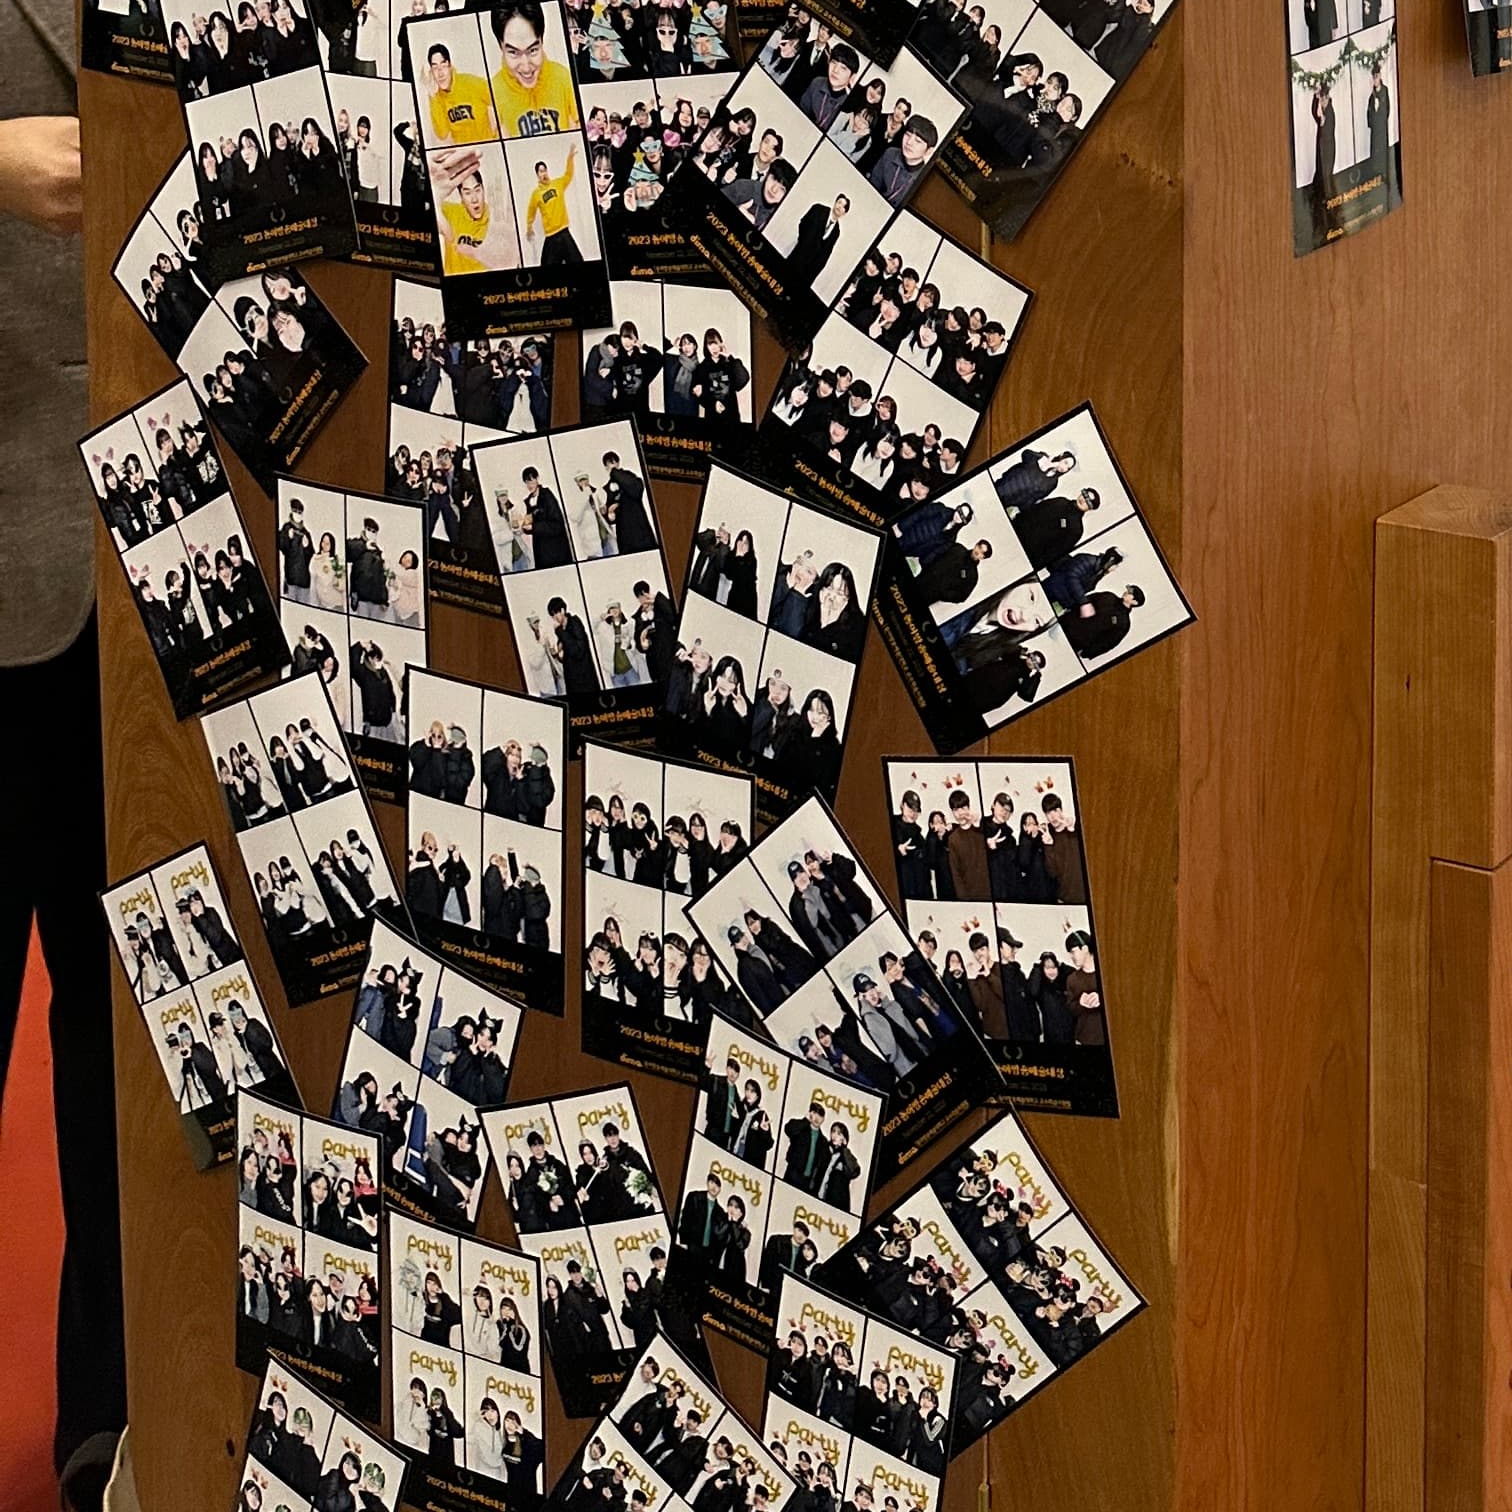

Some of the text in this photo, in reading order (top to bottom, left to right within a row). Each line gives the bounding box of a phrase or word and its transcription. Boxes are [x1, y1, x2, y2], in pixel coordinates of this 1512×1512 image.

[447, 104, 475, 123] OBEY
[517, 107, 561, 137] OBEY
[354, 222, 372, 233] 023
[704, 210, 730, 237] 2023
[628, 234, 650, 245] 2023
[688, 231, 714, 259] dima
[483, 293, 505, 305] 2023
[792, 458, 820, 482] 2023
[887, 582, 909, 614] 2023
[570, 715, 591, 726] 2023
[694, 749, 722, 767] 2023
[440, 940, 463, 955] 2023
[618, 1024, 643, 1039] 2023
[729, 1044, 779, 1091] party
[811, 1088, 870, 1133] party
[880, 1114, 902, 1138] 2023
[710, 1160, 762, 1206] party
[408, 1234, 453, 1272] party
[481, 1260, 530, 1296] party
[706, 1283, 733, 1303] 2023
[989, 1315, 1039, 1380] party
[410, 1351, 457, 1387] party
[590, 1372, 613, 1384] 2023
[886, 1346, 945, 1392] party
[486, 1376, 535, 1413] party
